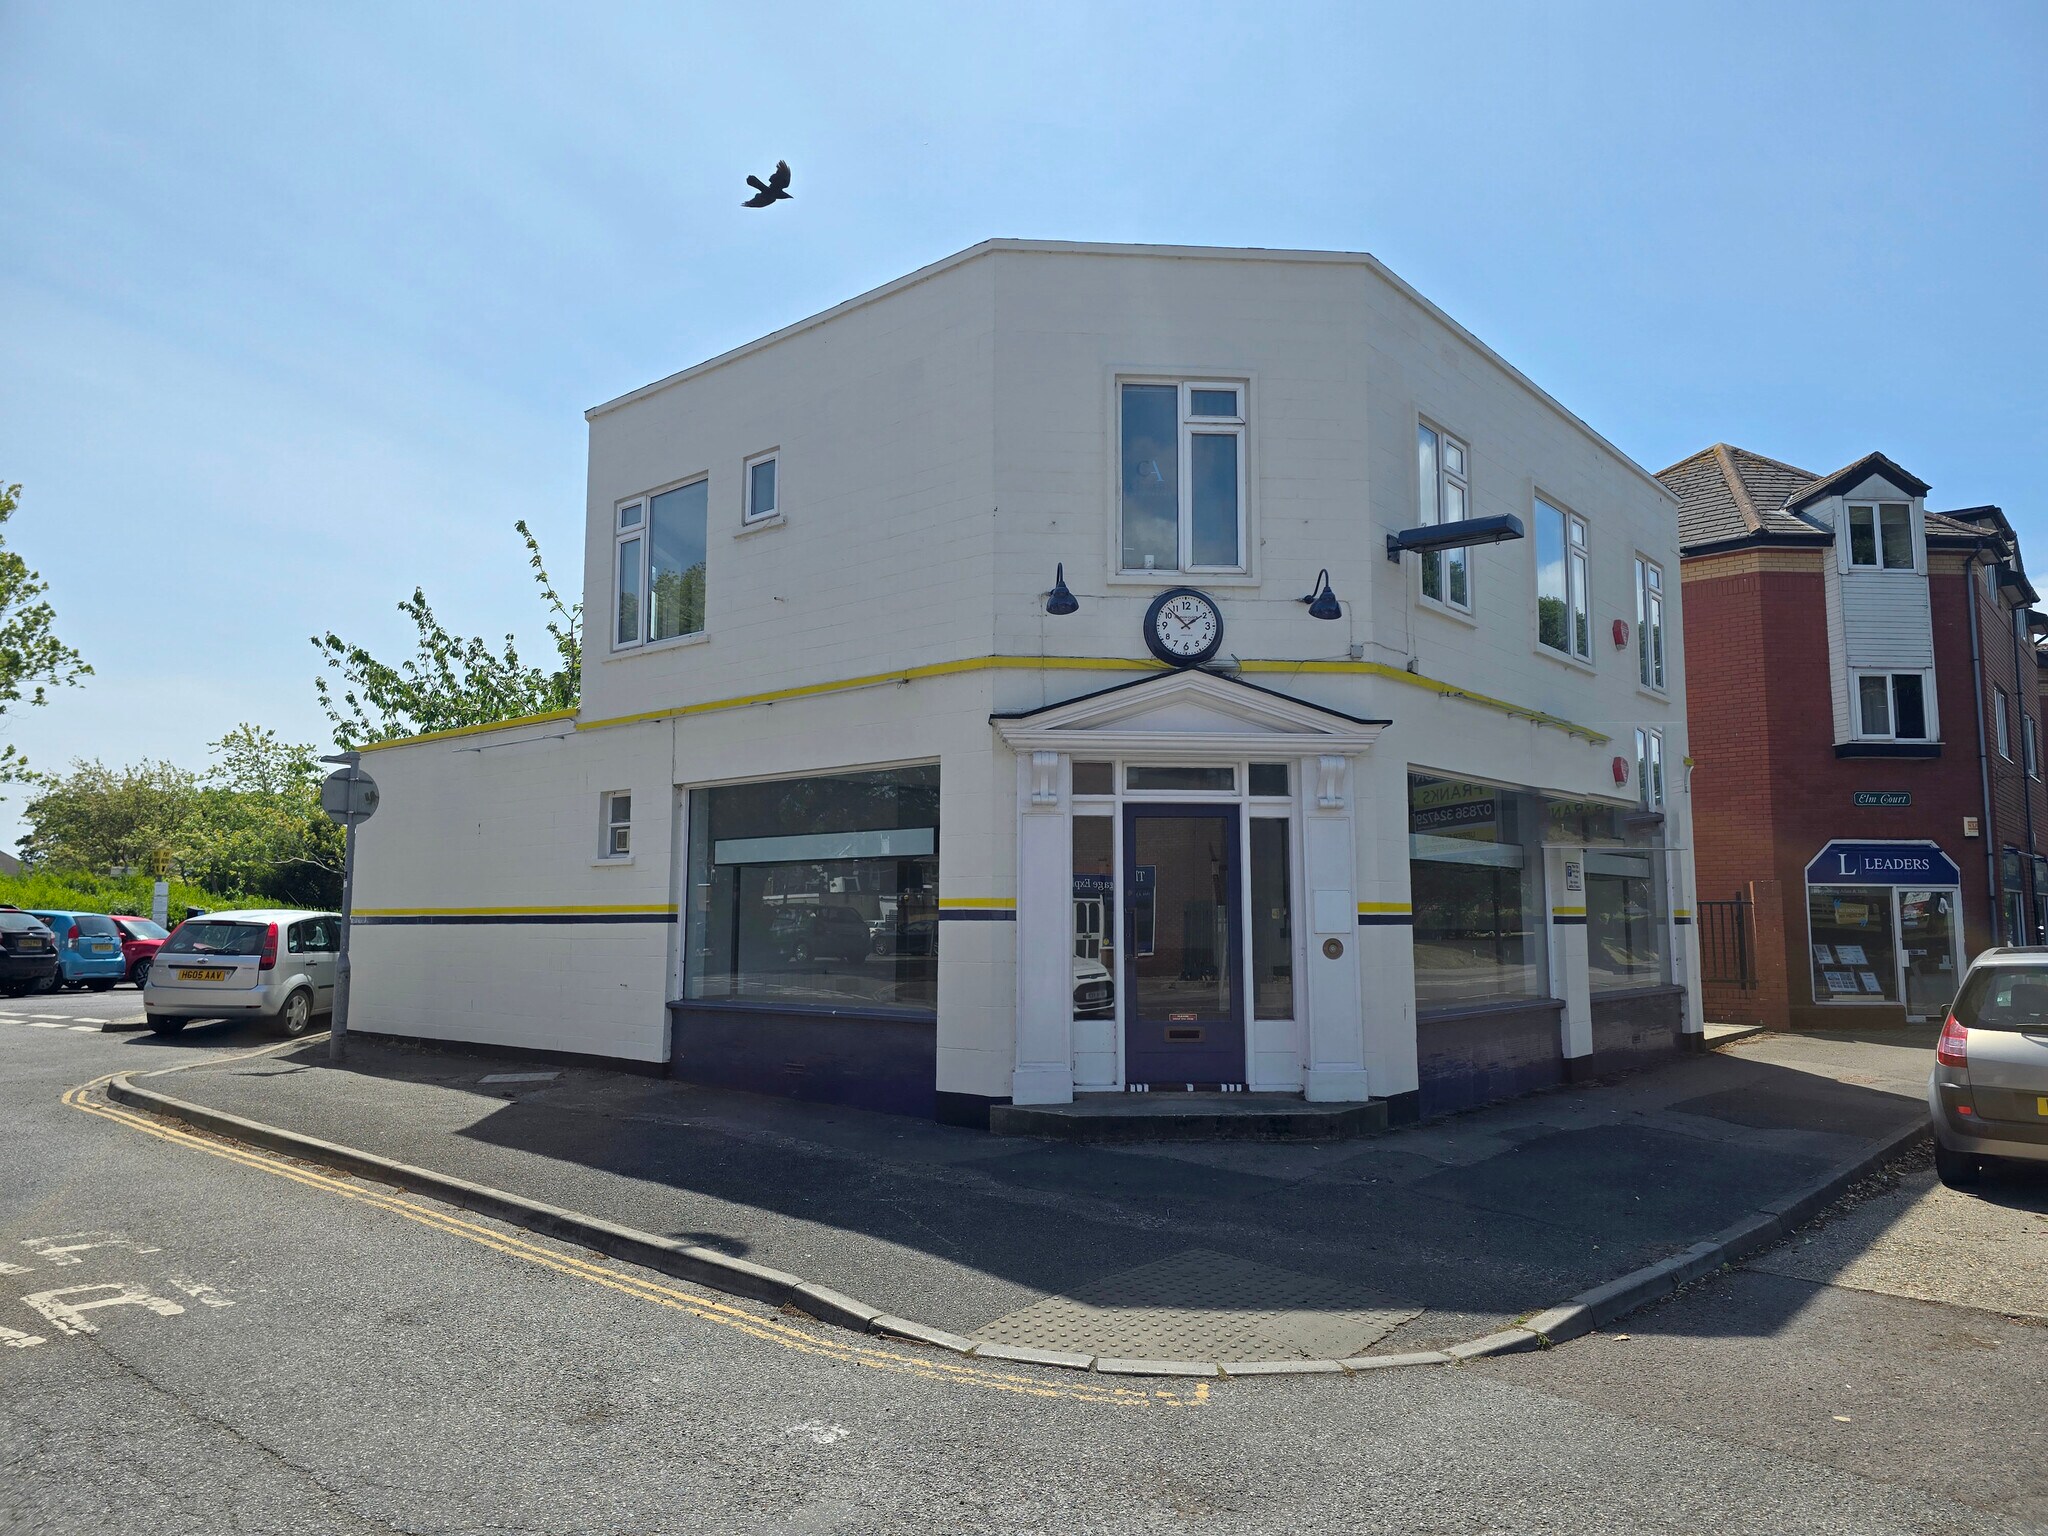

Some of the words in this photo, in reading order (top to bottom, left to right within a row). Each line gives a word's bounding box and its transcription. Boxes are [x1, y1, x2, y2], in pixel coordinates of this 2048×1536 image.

[1182, 601, 1191, 610] 12
[1162, 621, 1168, 630] 9
[1205, 622, 1211, 630] 3
[1183, 642, 1189, 651] 6
[1858, 793, 1876, 803] Elm
[1880, 793, 1906, 804] Court
[1838, 853, 1857, 876] L
[1864, 858, 1930, 871] LEADERS
[181, 970, 204, 980] HG05
[205, 971, 223, 980] AAV
